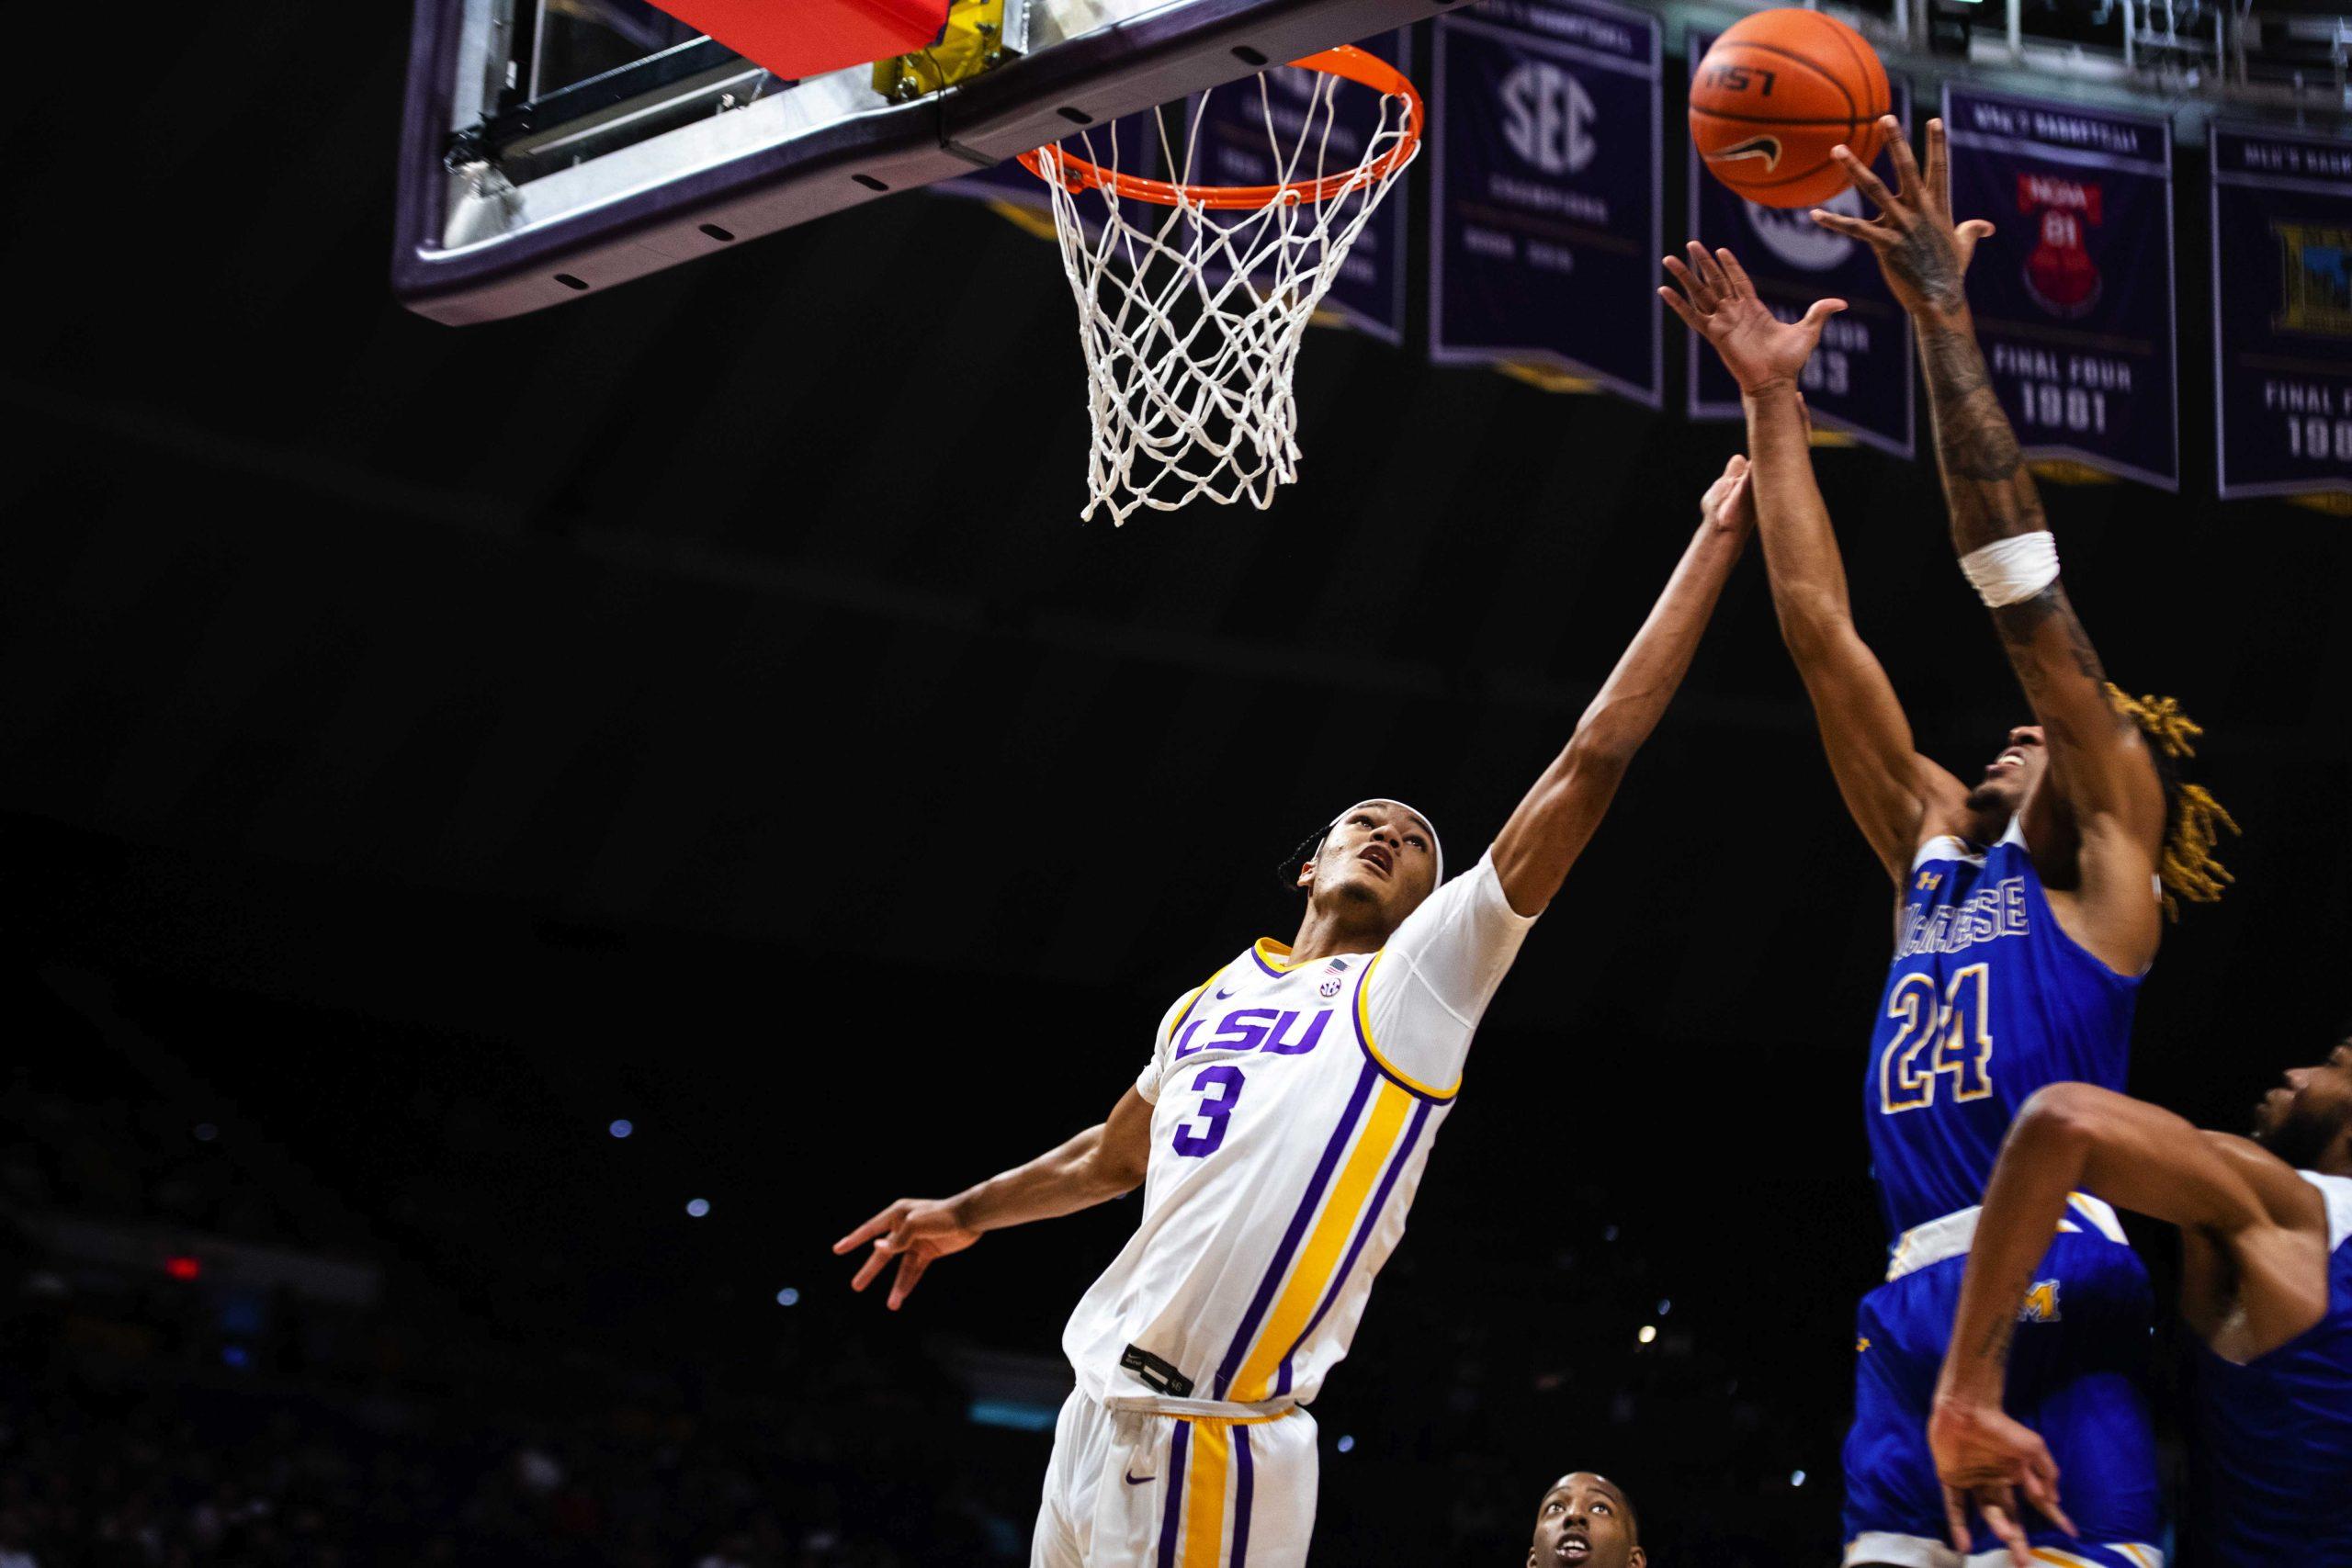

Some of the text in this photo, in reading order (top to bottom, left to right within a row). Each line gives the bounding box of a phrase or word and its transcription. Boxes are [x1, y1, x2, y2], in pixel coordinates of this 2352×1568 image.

[1499, 59, 1598, 175] SEC
[1994, 343, 2132, 395] FINAL FOUR
[2264, 378, 2334, 415] FINAL
[1175, 1008, 1334, 1062] LSU
[1880, 963, 1994, 1115] 24
[1171, 1065, 1246, 1158] 3
